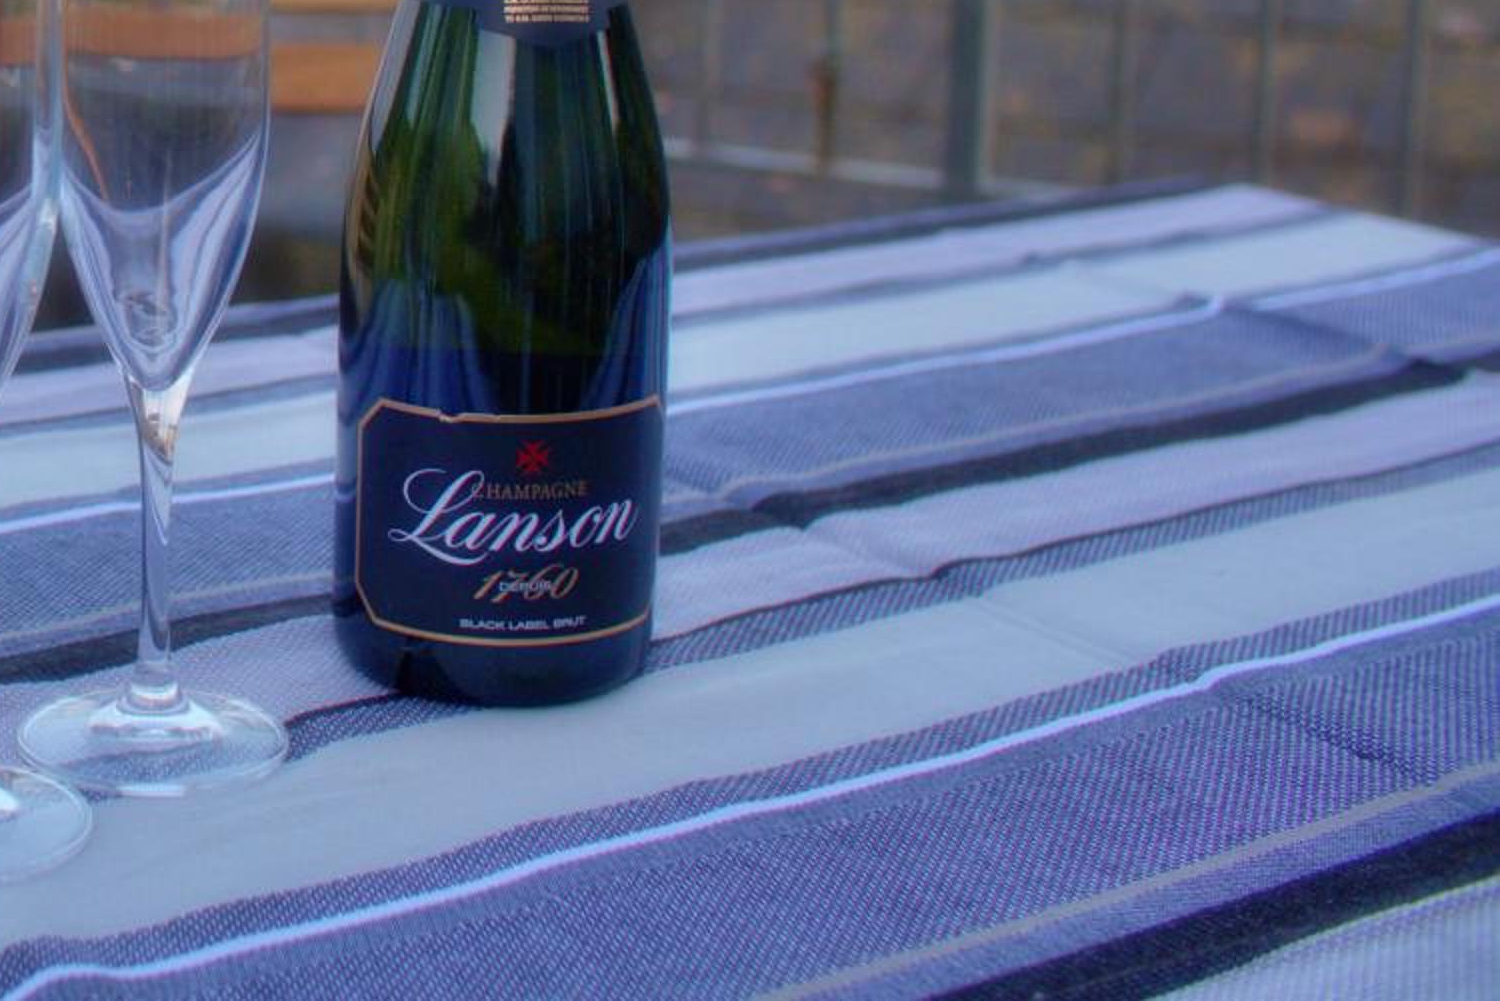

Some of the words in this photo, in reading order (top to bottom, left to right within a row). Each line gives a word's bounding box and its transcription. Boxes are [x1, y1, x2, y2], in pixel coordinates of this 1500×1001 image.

[472, 480, 588, 501] CHAMPAGNE
[388, 467, 641, 566] Lanson
[473, 563, 580, 604] 1760
[459, 617, 505, 630] BLACK
[508, 619, 549, 631] LABEL
[553, 615, 586, 629] BRUT
